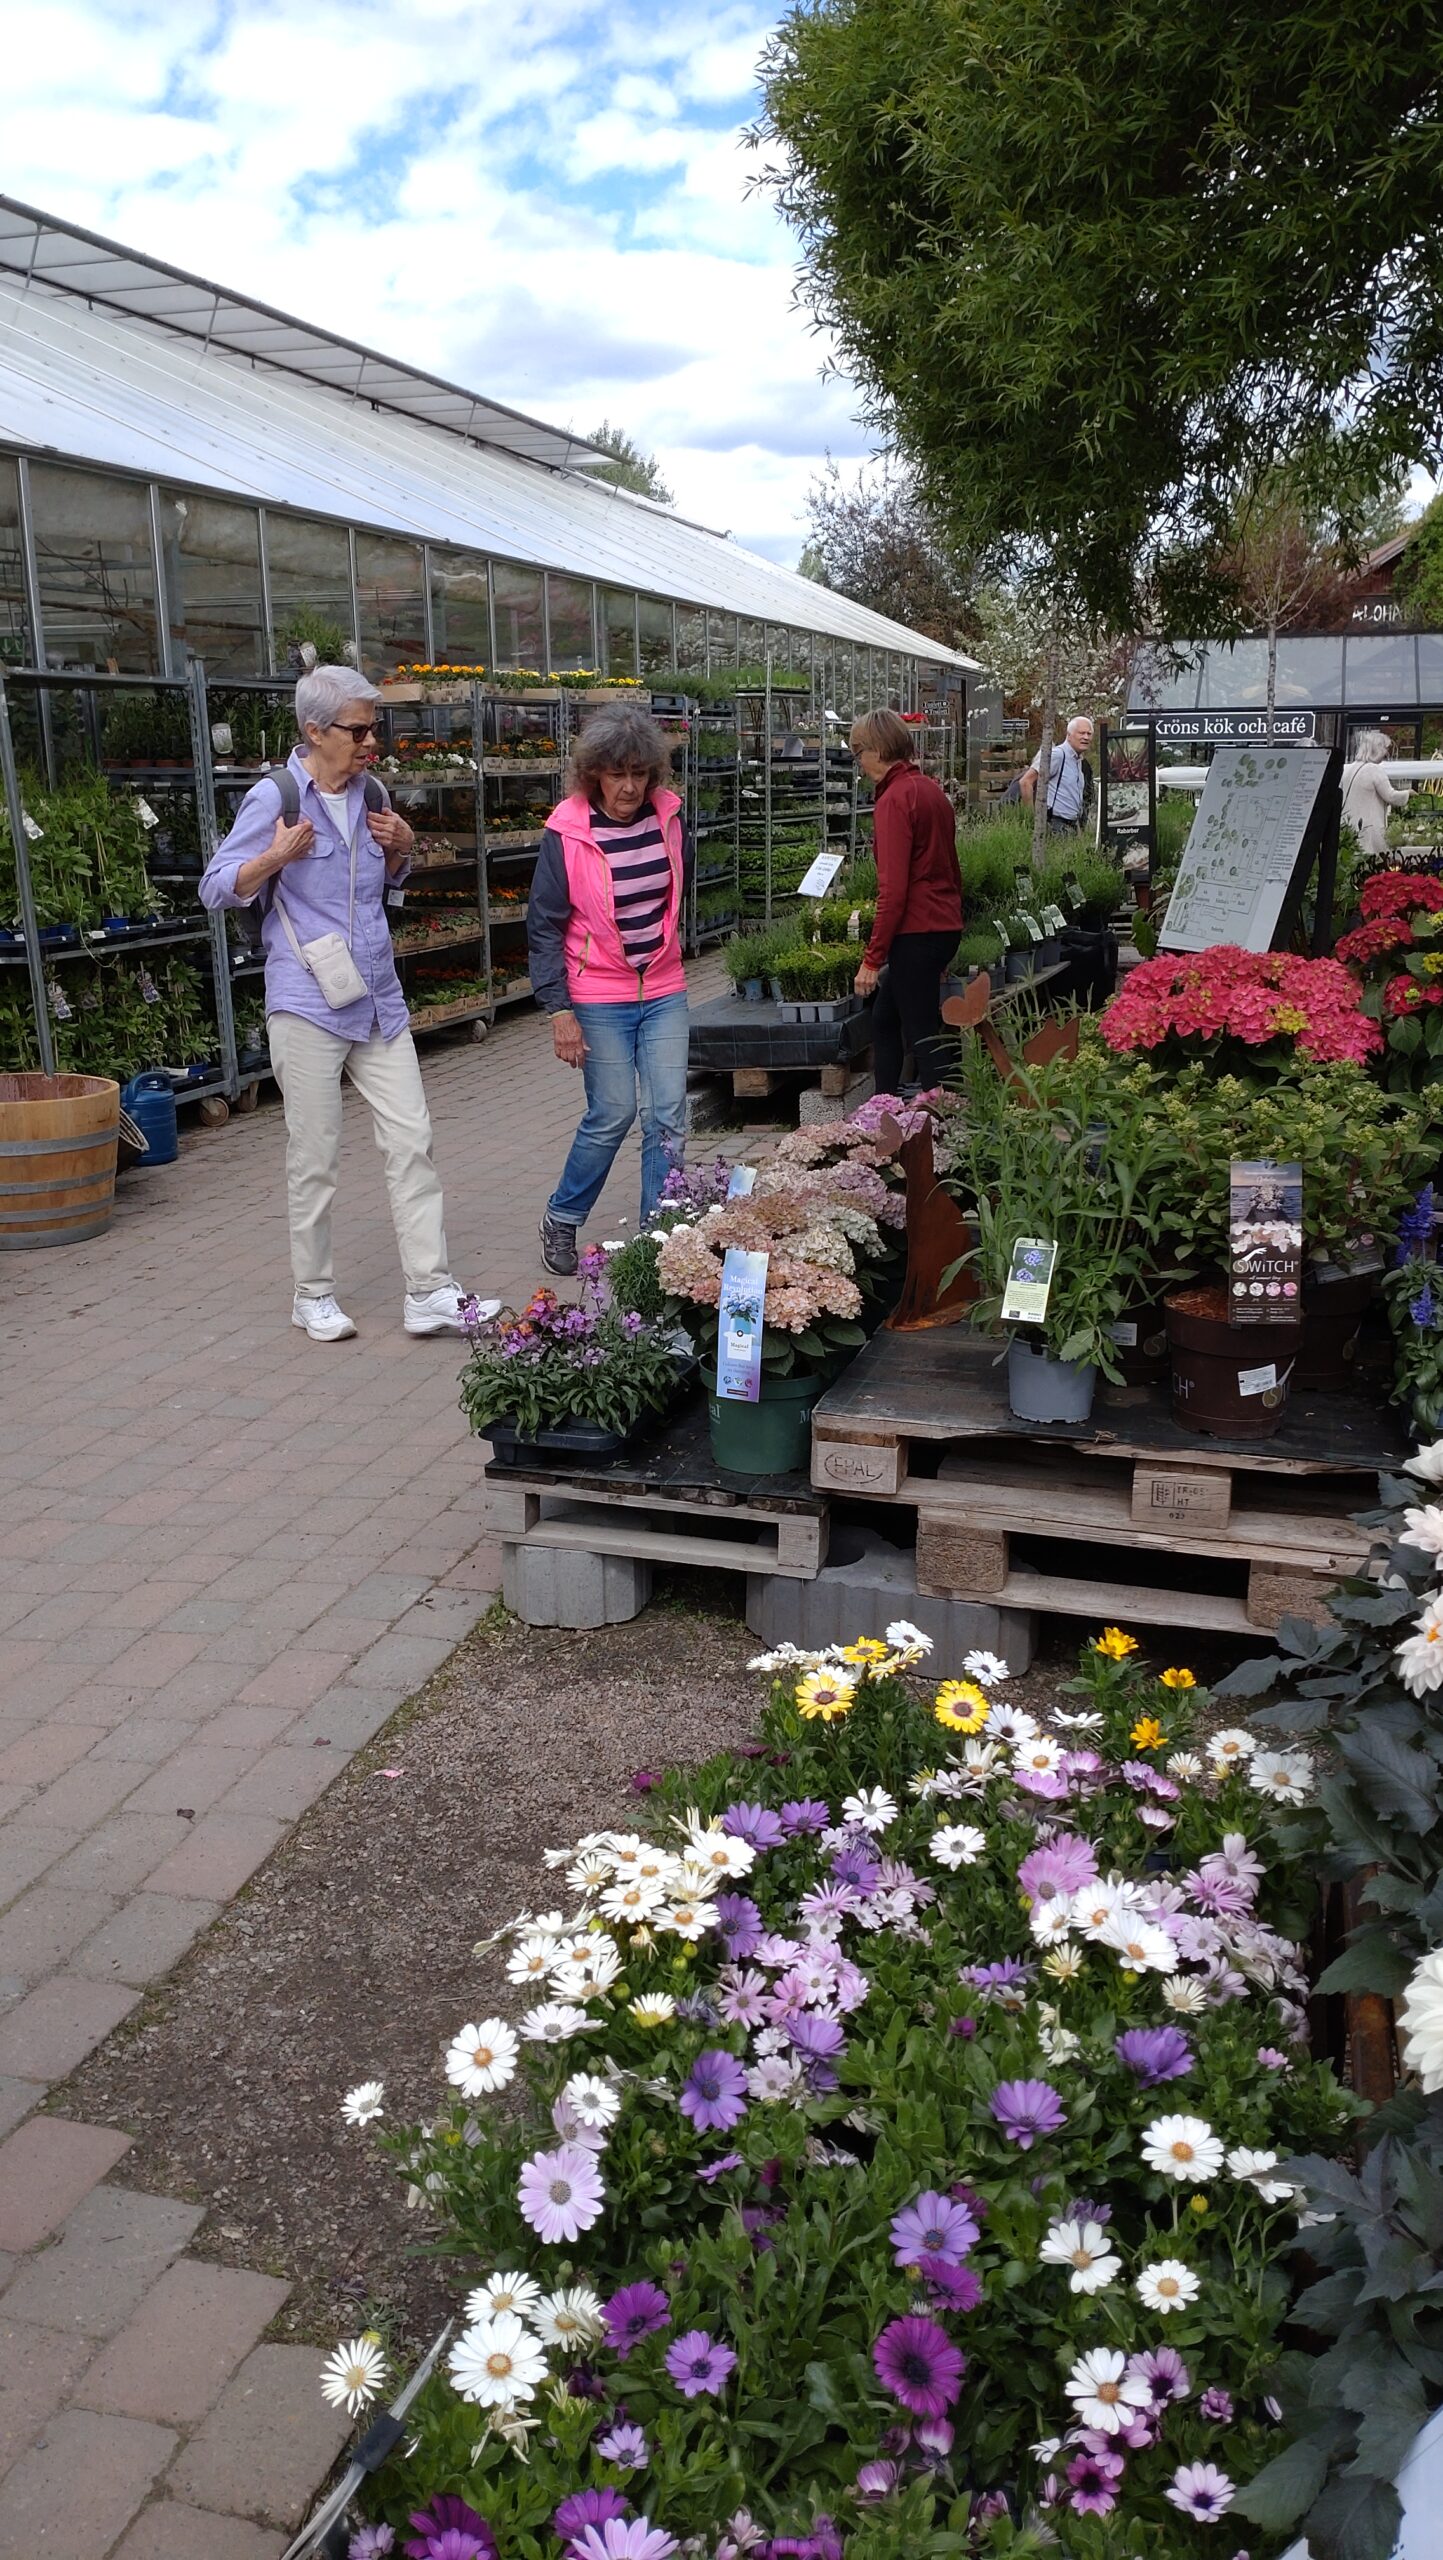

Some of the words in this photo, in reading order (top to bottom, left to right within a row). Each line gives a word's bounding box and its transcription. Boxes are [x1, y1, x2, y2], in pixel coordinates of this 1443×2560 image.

[1204, 718, 1234, 734] kök
[1238, 717, 1267, 734] och
[1273, 716, 1306, 734] café
[833, 1456, 876, 1477] EPAL
